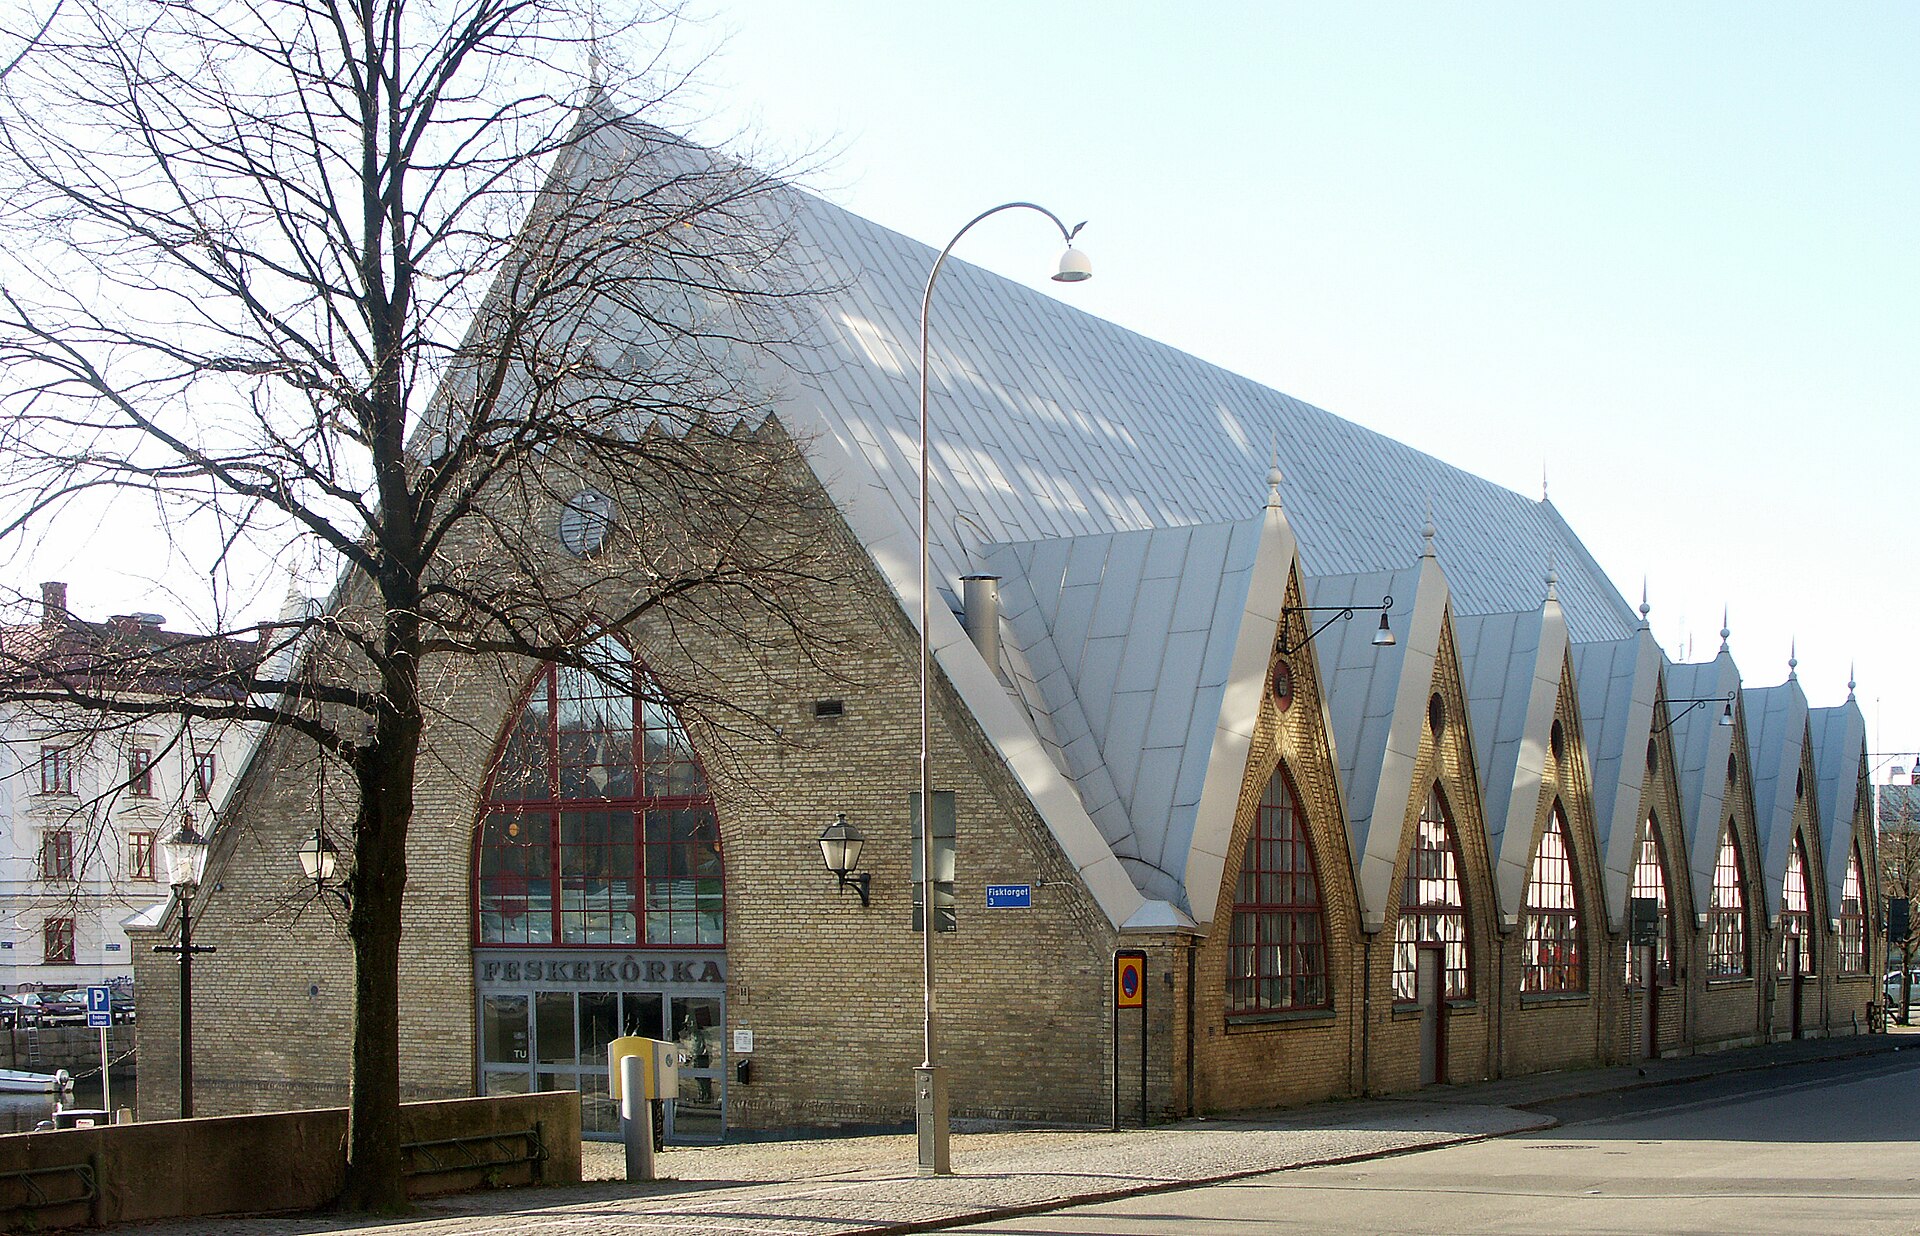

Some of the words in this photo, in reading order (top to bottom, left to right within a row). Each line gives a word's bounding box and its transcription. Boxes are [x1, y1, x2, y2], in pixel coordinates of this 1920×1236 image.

[989, 888, 1028, 897] Fisktorget
[482, 955, 724, 982] FESKEKÔRKA
[93, 989, 105, 1010] P
